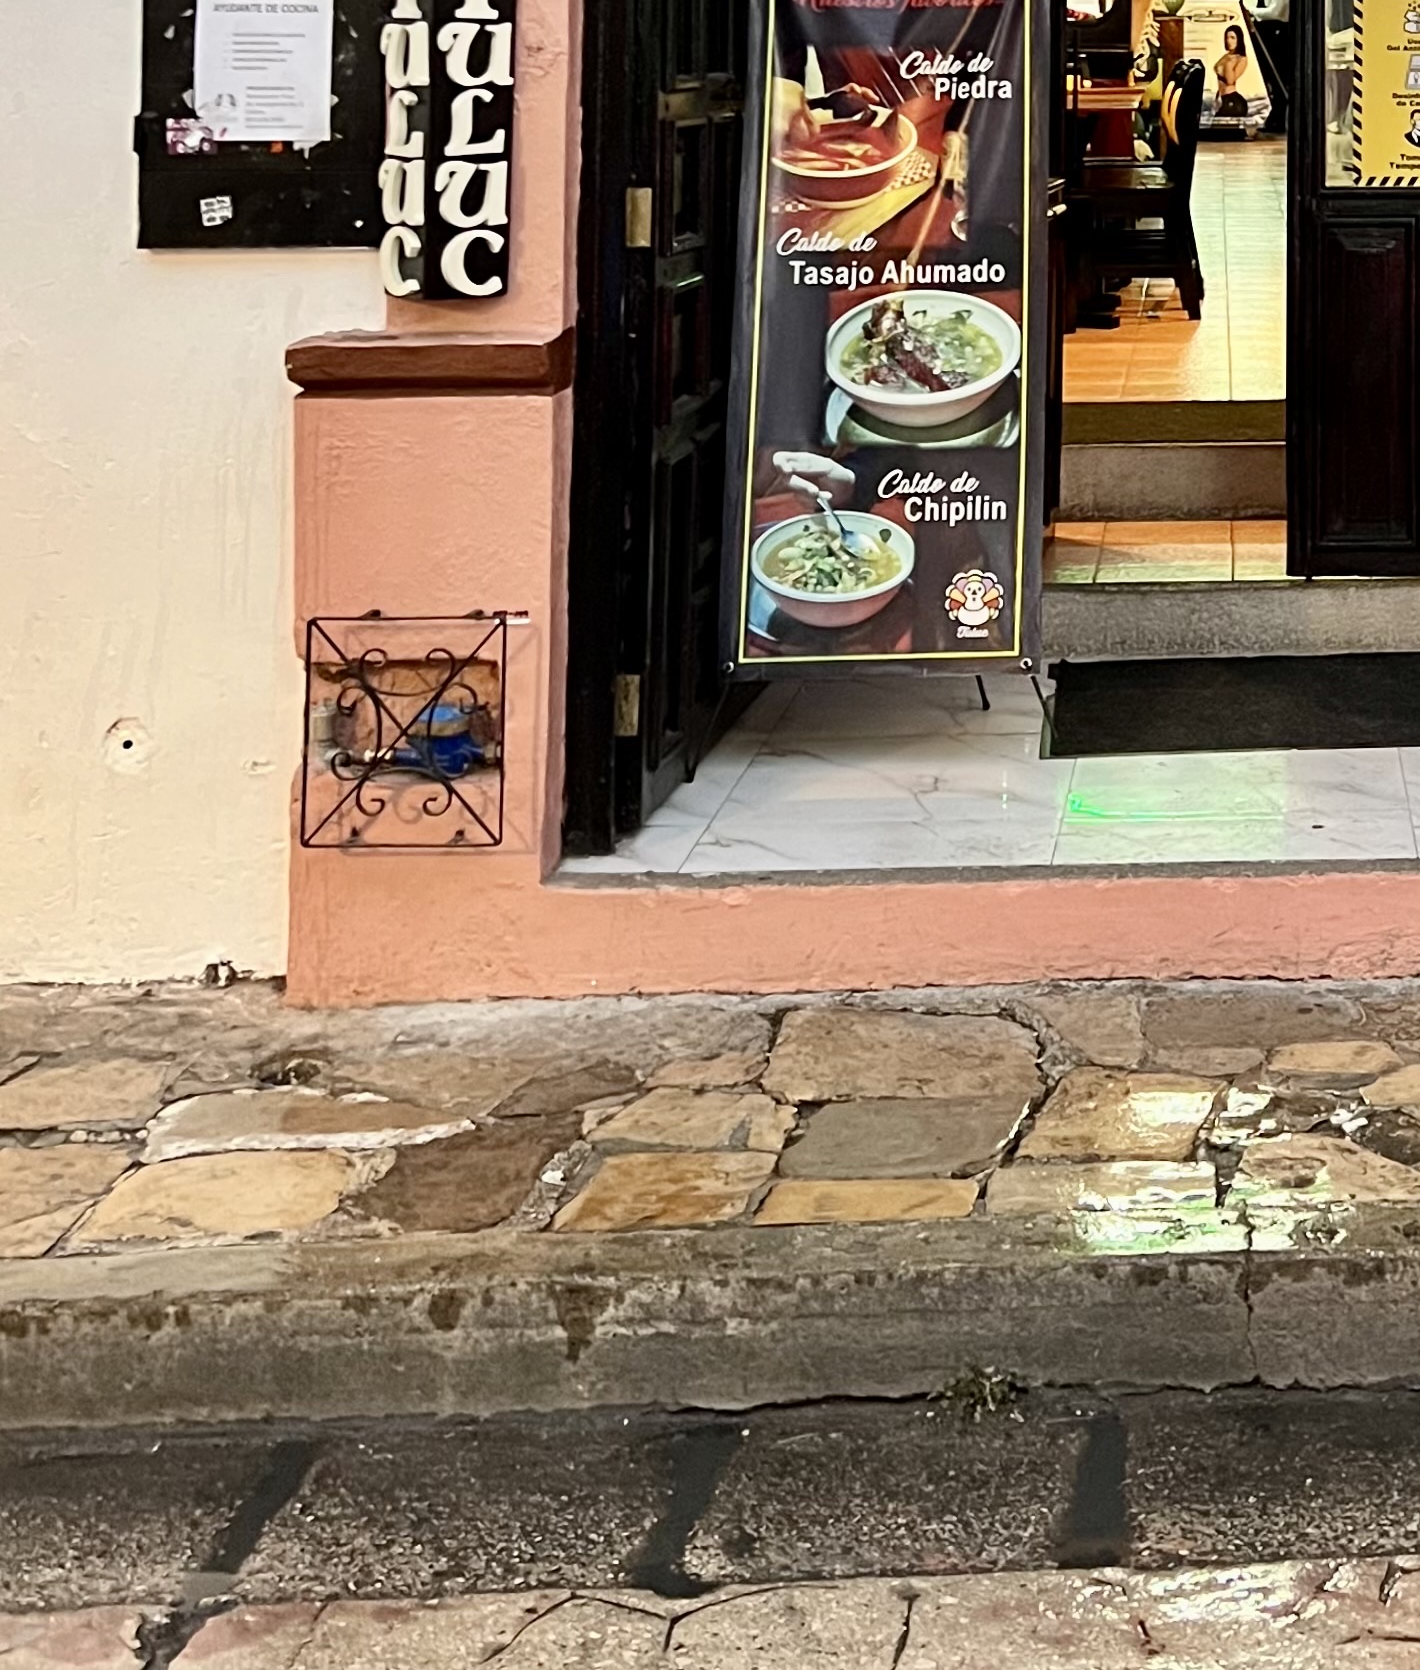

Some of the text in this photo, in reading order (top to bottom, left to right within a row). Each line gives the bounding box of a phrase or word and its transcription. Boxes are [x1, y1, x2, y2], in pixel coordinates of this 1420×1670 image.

[899, 50, 995, 80] Caldo de
[934, 77, 1012, 101] Piedra
[775, 227, 878, 257] Caldo de
[788, 258, 1006, 291] Tasajo Ahumado
[876, 468, 979, 499] Caldo de
[903, 494, 1007, 527] Chipilin
